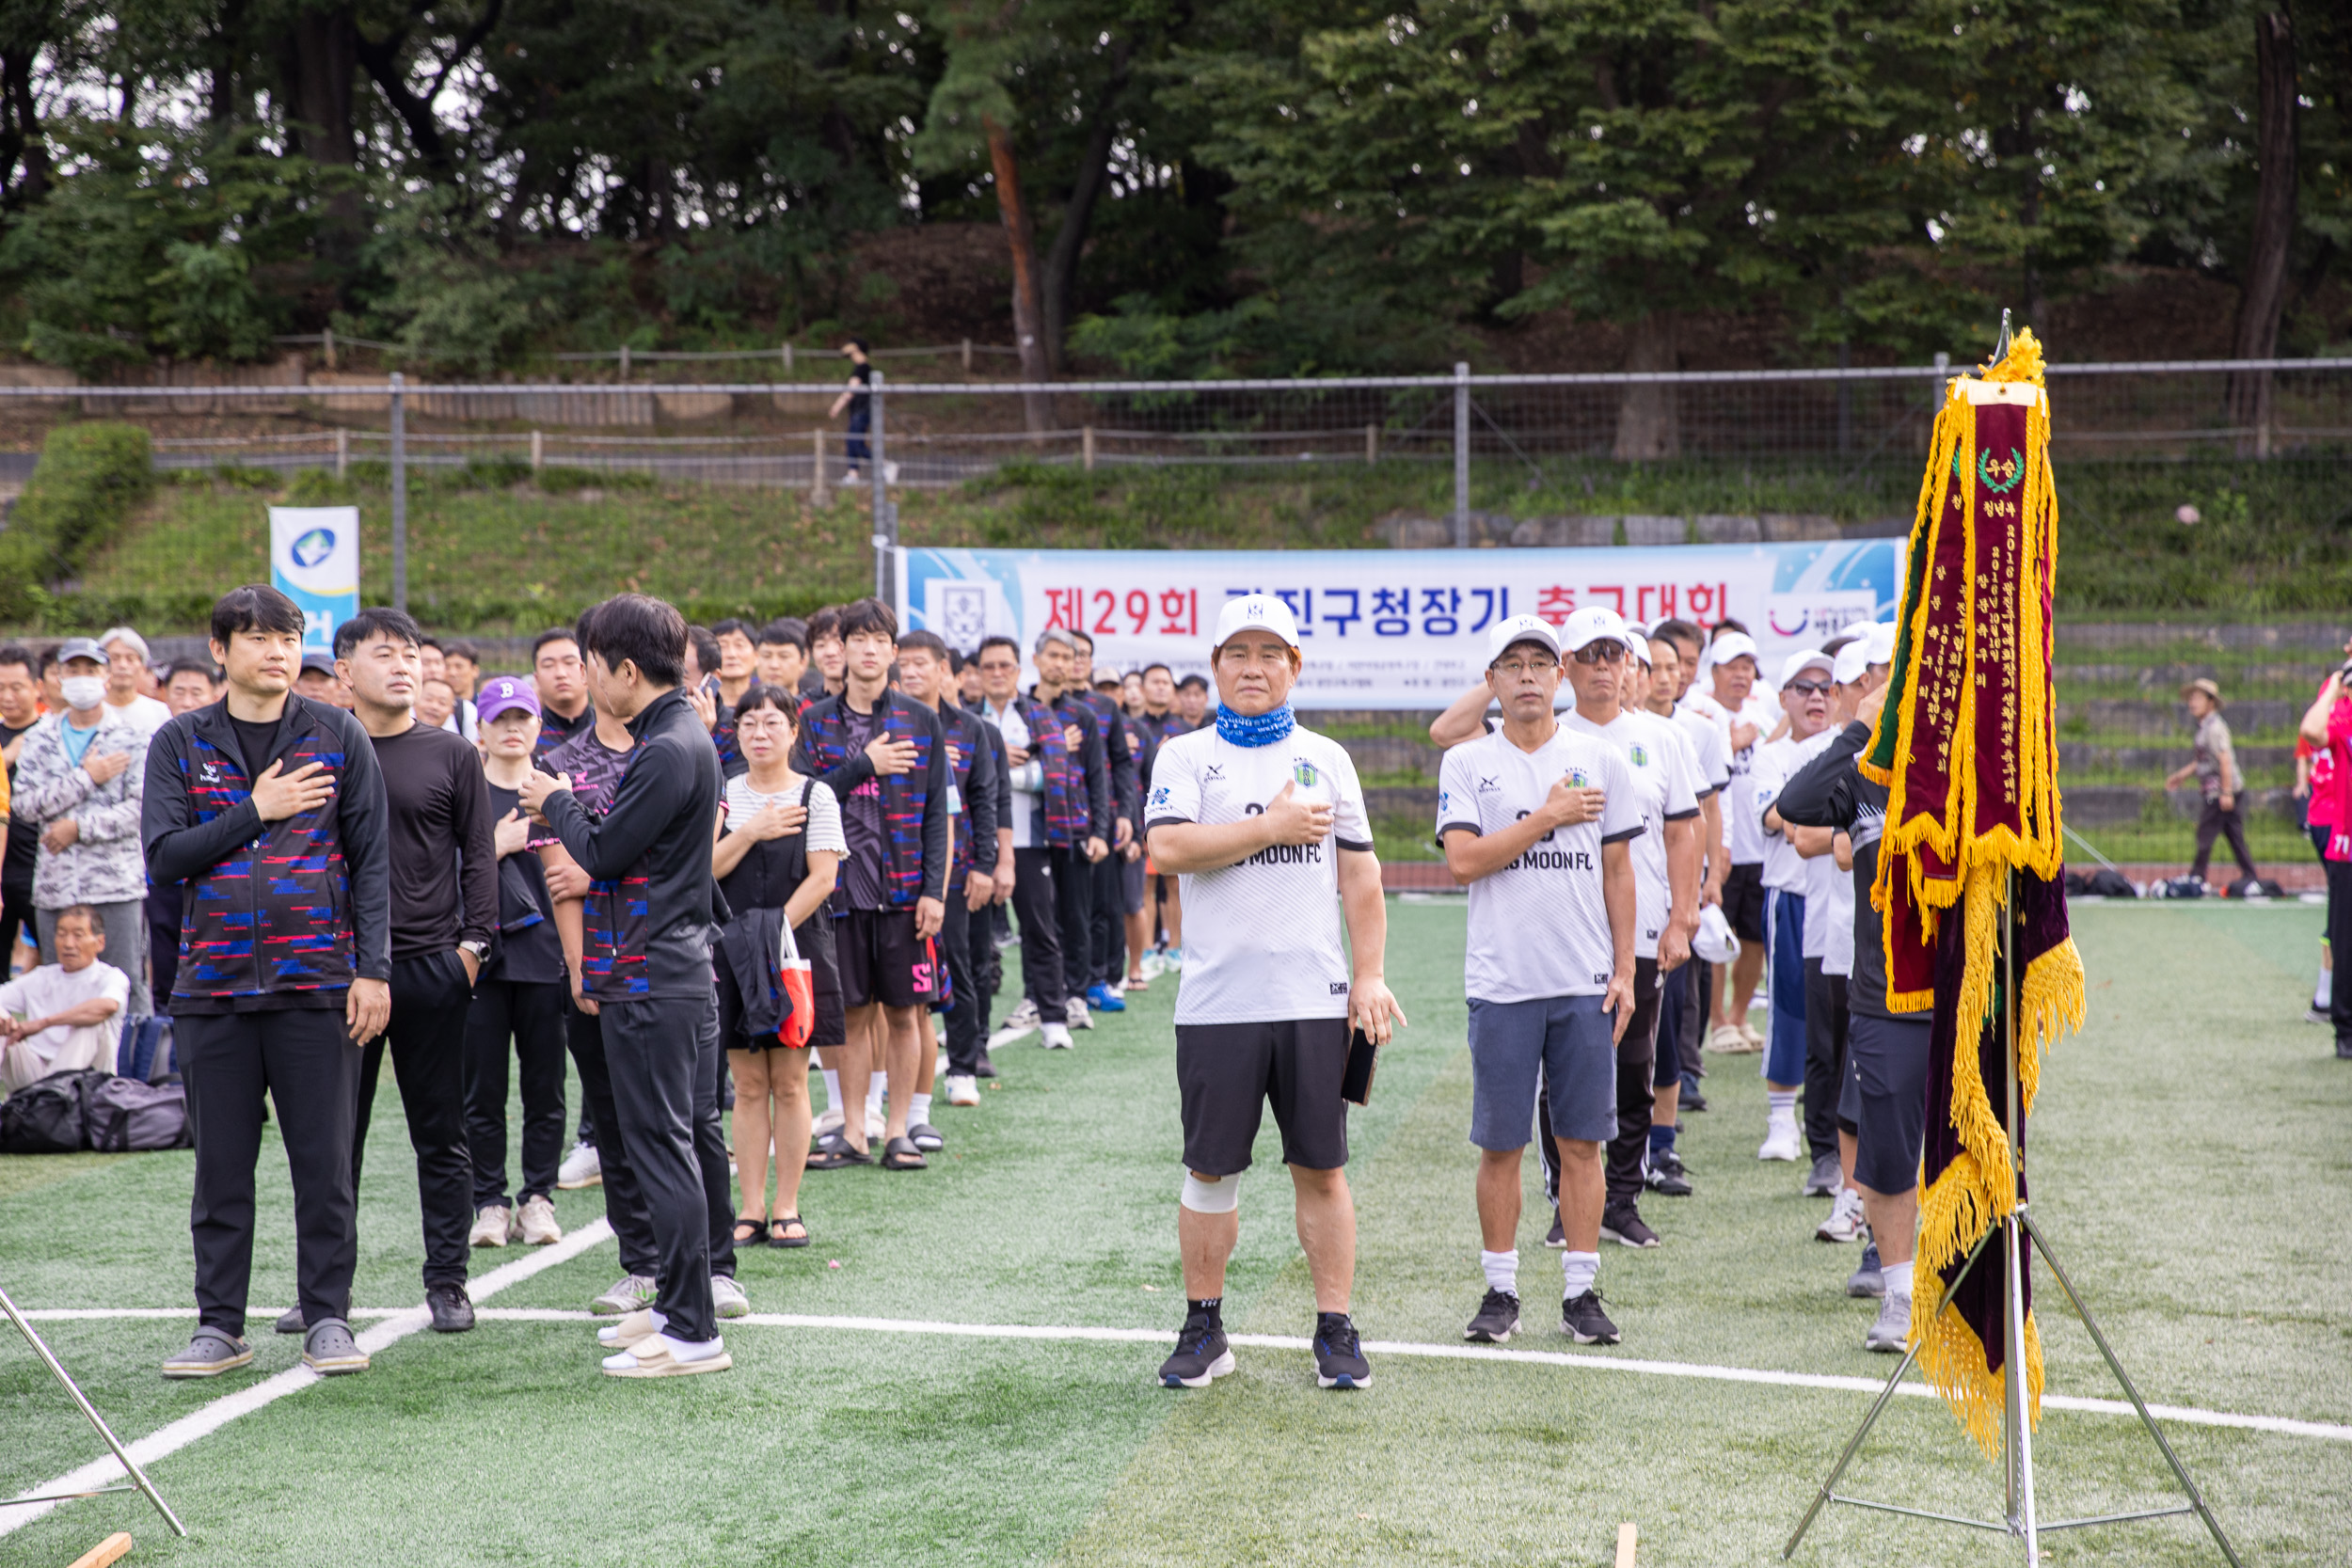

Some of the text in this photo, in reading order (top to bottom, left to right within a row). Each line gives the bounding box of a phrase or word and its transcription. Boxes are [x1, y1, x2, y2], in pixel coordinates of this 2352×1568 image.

[1985, 458, 2015, 479] 우승
[1983, 499, 2016, 518] 청년부
[2006, 524, 2015, 578] 2016
[1044, 587, 1198, 636] 제29회
[1225, 586, 1508, 637] 진구청장기
[500, 682, 515, 699] B
[1249, 843, 1303, 865] MOON
[1306, 843, 1322, 863] FC
[1523, 850, 1573, 870] MOON
[1576, 852, 1594, 871] FC
